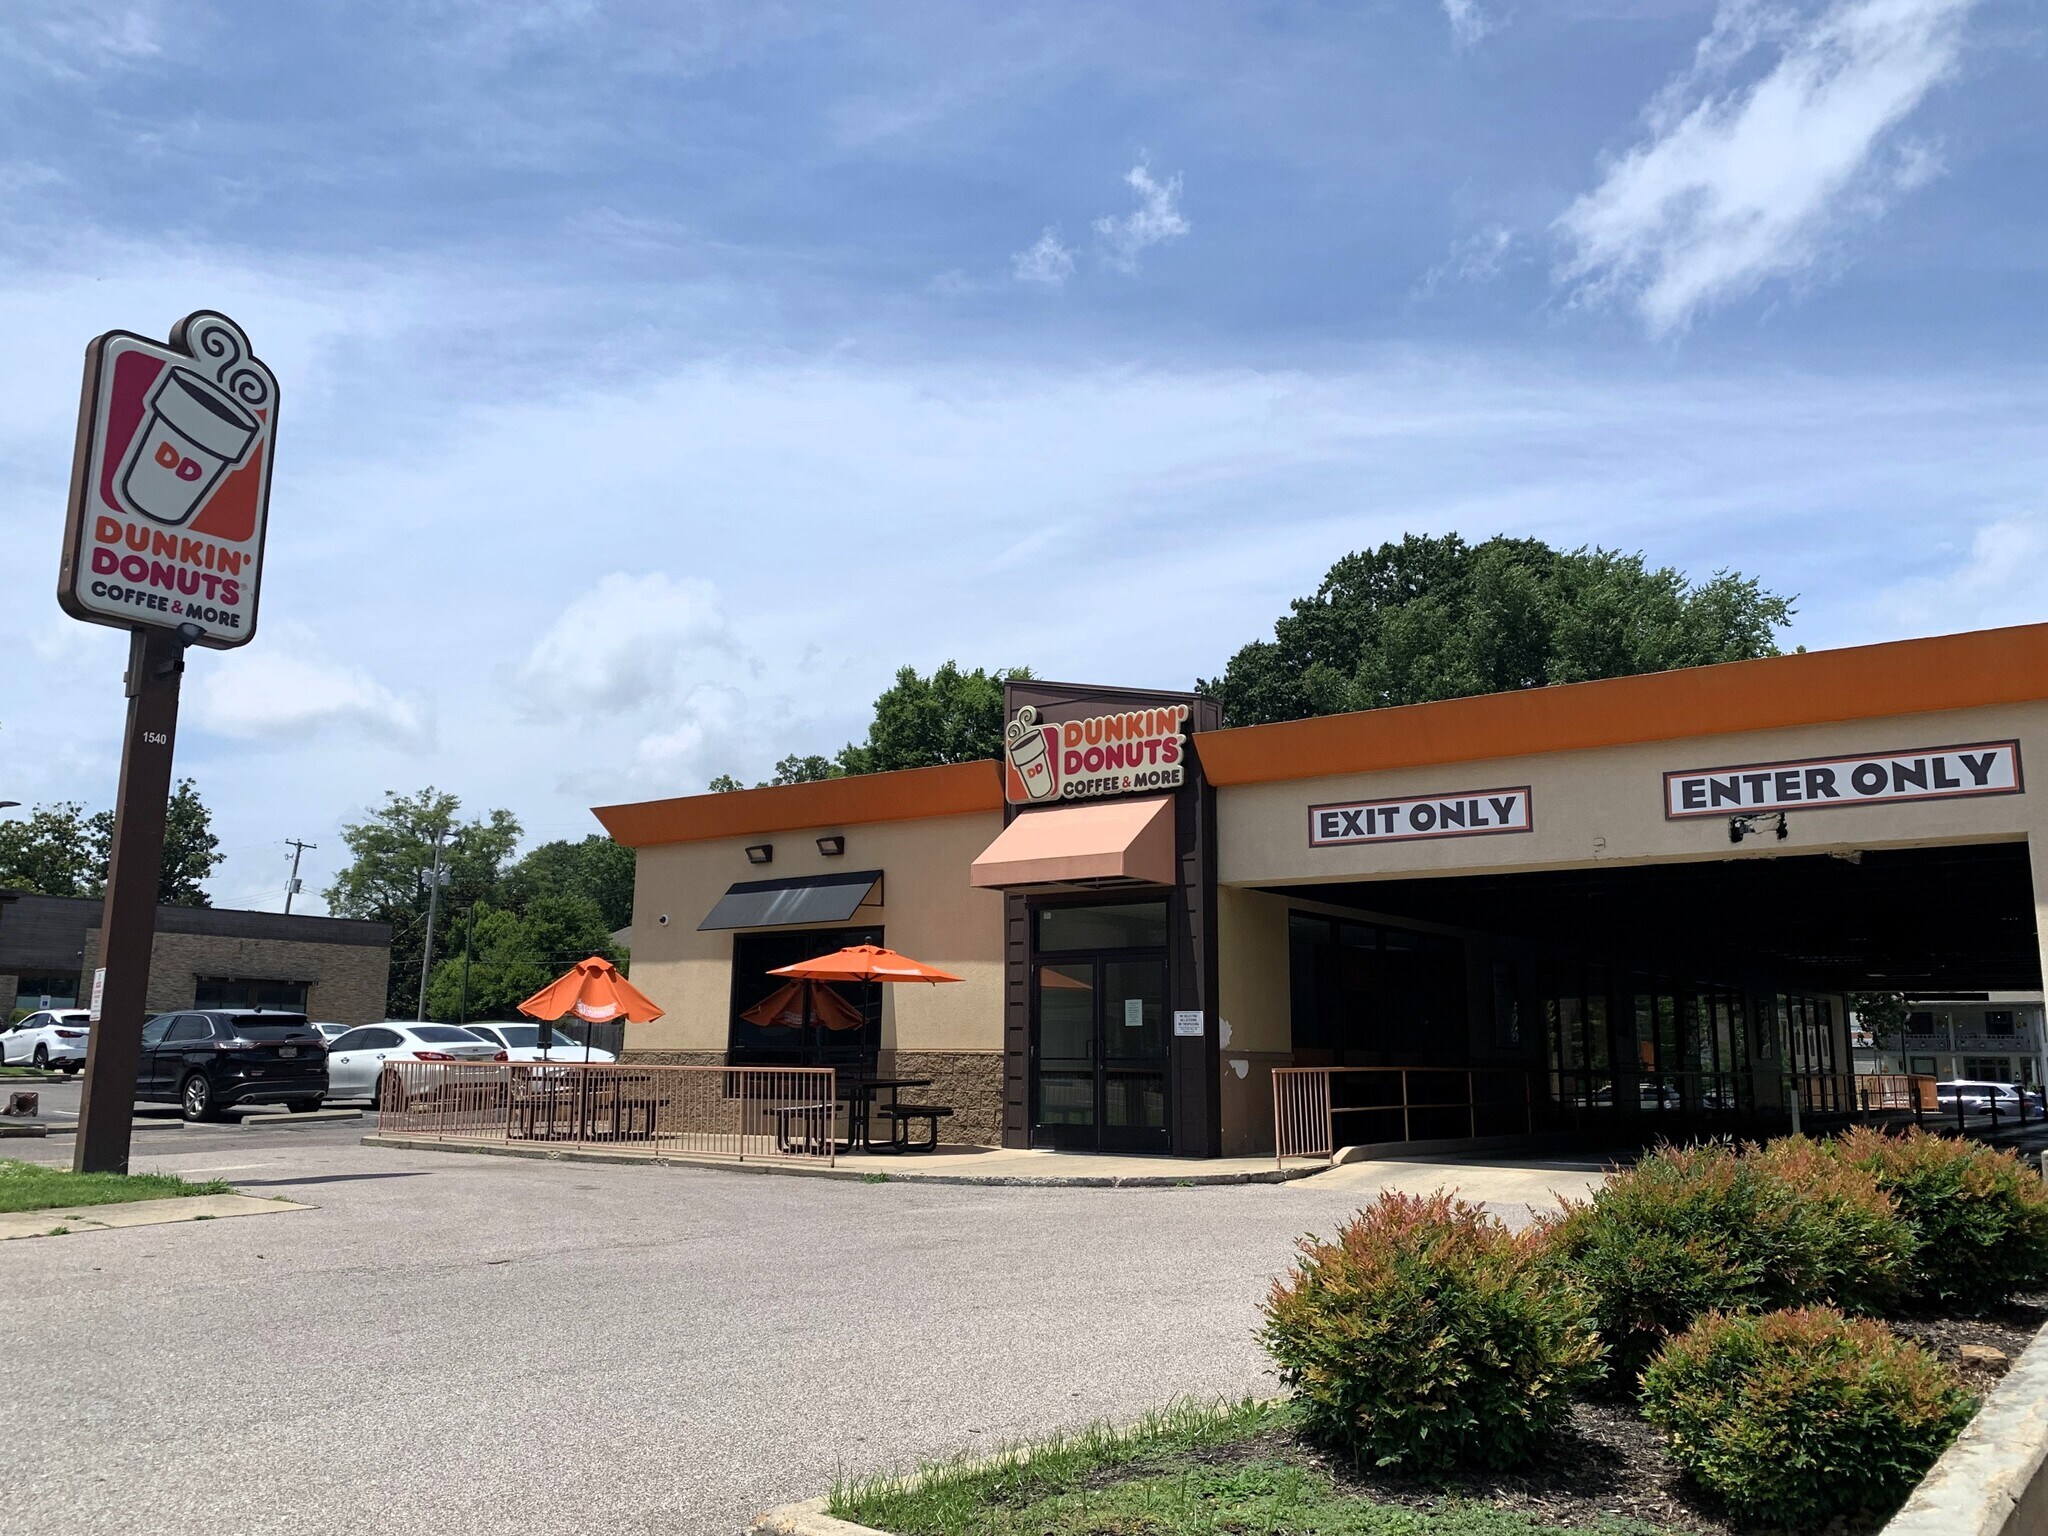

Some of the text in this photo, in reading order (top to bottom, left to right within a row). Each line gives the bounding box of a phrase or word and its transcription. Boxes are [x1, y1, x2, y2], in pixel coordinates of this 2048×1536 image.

[155, 441, 202, 481] DD
[95, 515, 251, 576] DUNKIN'
[92, 547, 240, 605] DONUTS
[91, 581, 240, 628] COFFEE & MORE
[143, 731, 167, 745] 1540
[1064, 707, 1184, 748] DUNKIN'
[1027, 763, 1043, 779] DD
[1064, 737, 1179, 775] DONUTS
[1063, 769, 1181, 796] COFFEE & MORE
[1682, 752, 1998, 810] ENTER ONLY
[1320, 796, 1517, 838] EXIT ONLY
